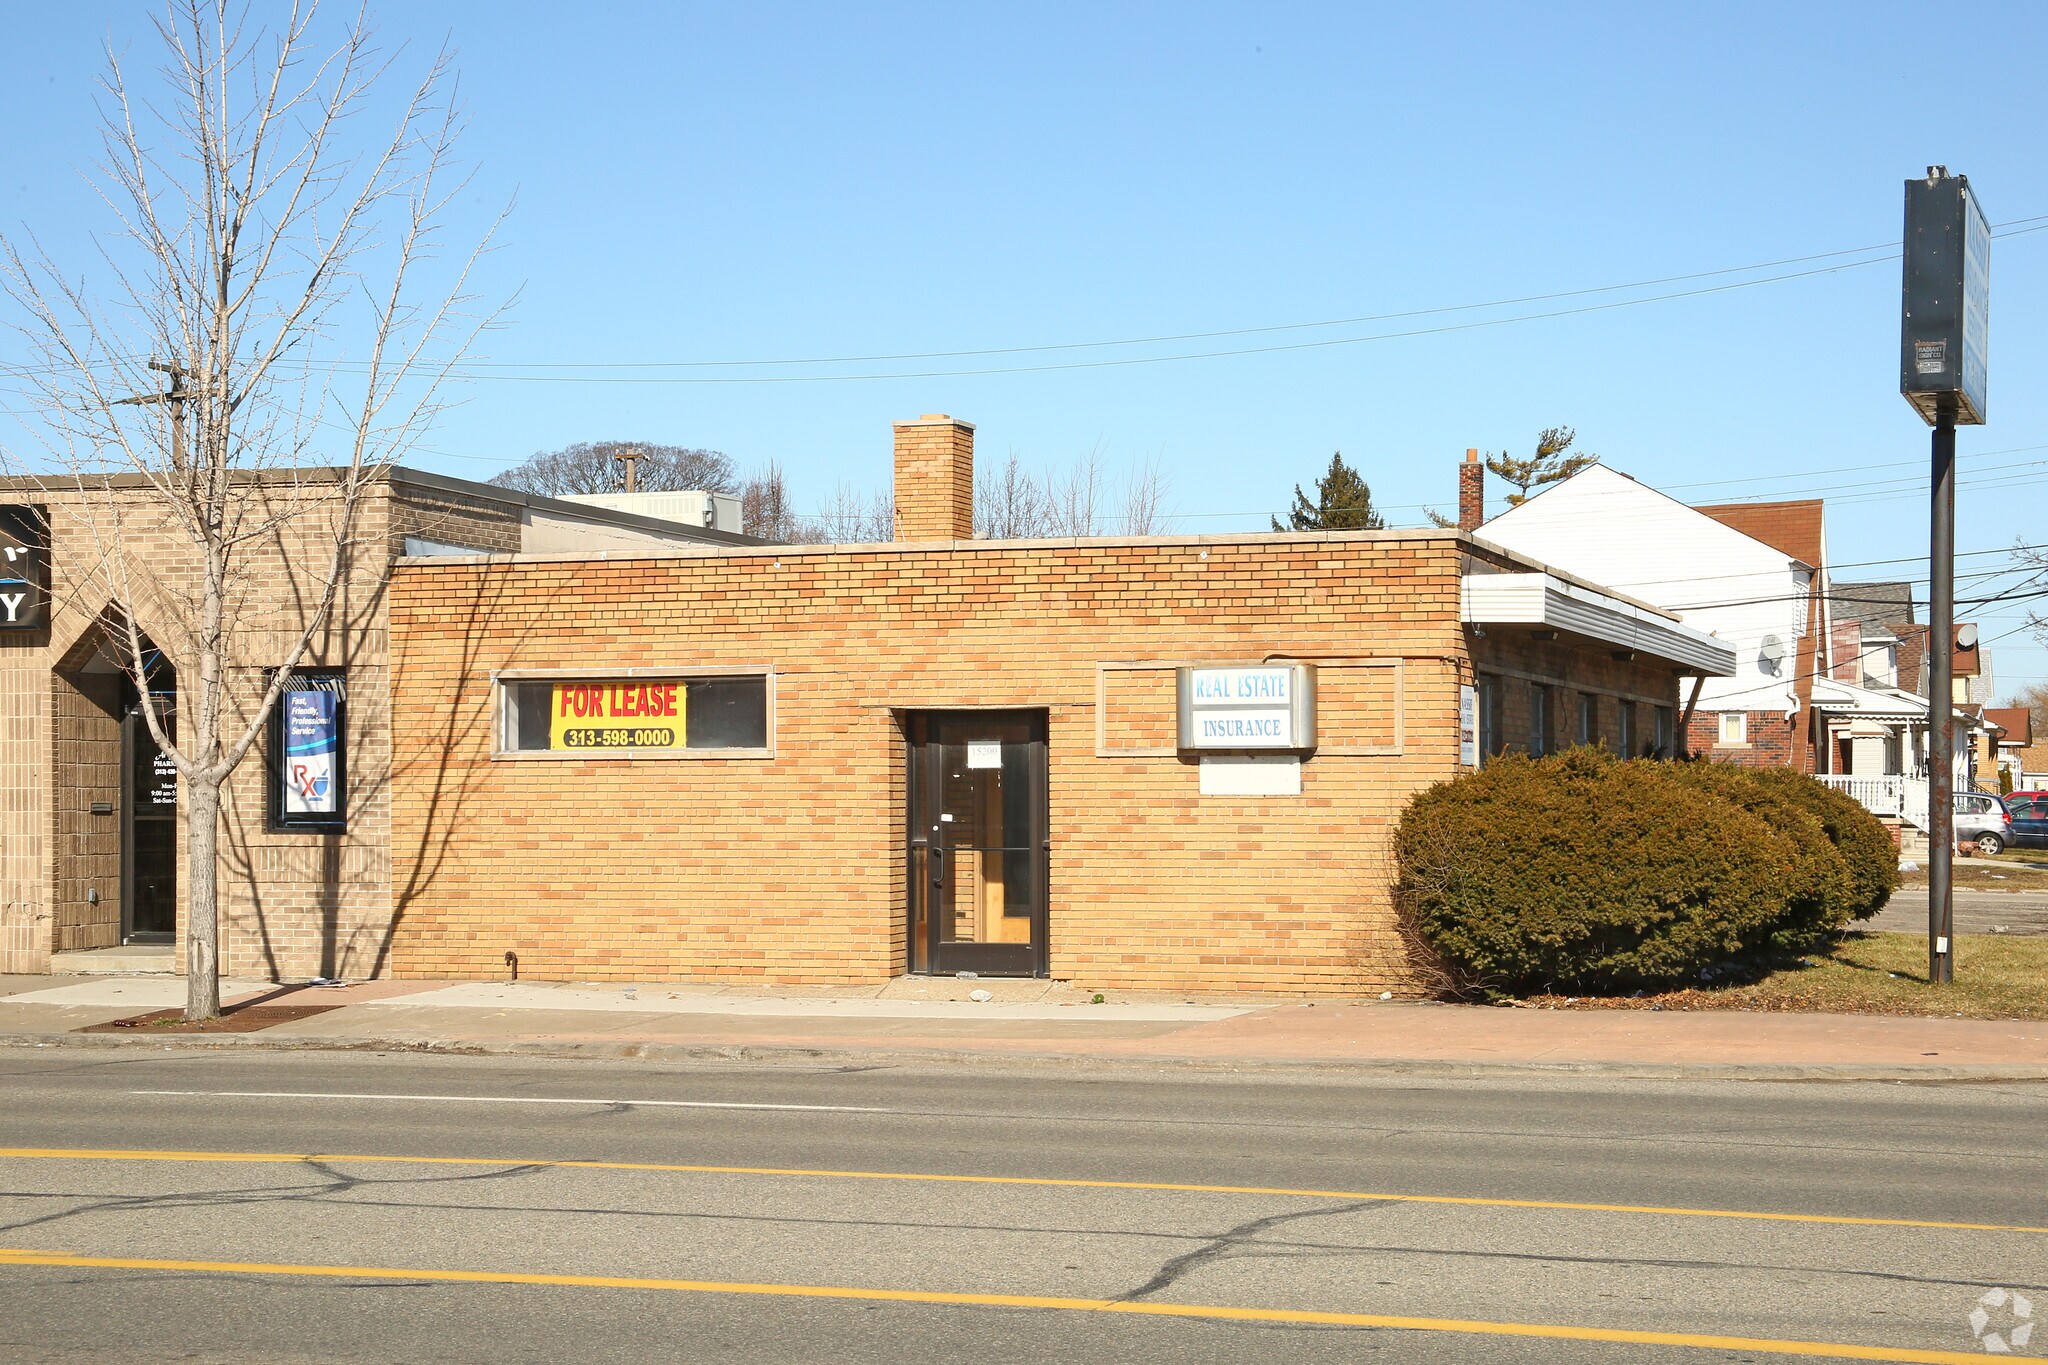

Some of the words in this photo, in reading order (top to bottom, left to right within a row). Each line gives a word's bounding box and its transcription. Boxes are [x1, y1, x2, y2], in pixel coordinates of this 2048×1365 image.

[0, 593, 26, 622] Y
[1196, 675, 1231, 698] REAL
[1237, 675, 1285, 697] ESTATE
[291, 697, 307, 706] Fast,
[560, 683, 604, 718] FOR
[609, 683, 678, 717] LEASE
[291, 707, 319, 716] Friendly,
[291, 717, 331, 725] Professional
[291, 727, 316, 735] Service
[1203, 719, 1281, 737] INSURANCE
[569, 729, 670, 746] 313-598-0000
[972, 747, 998, 756] 15200
